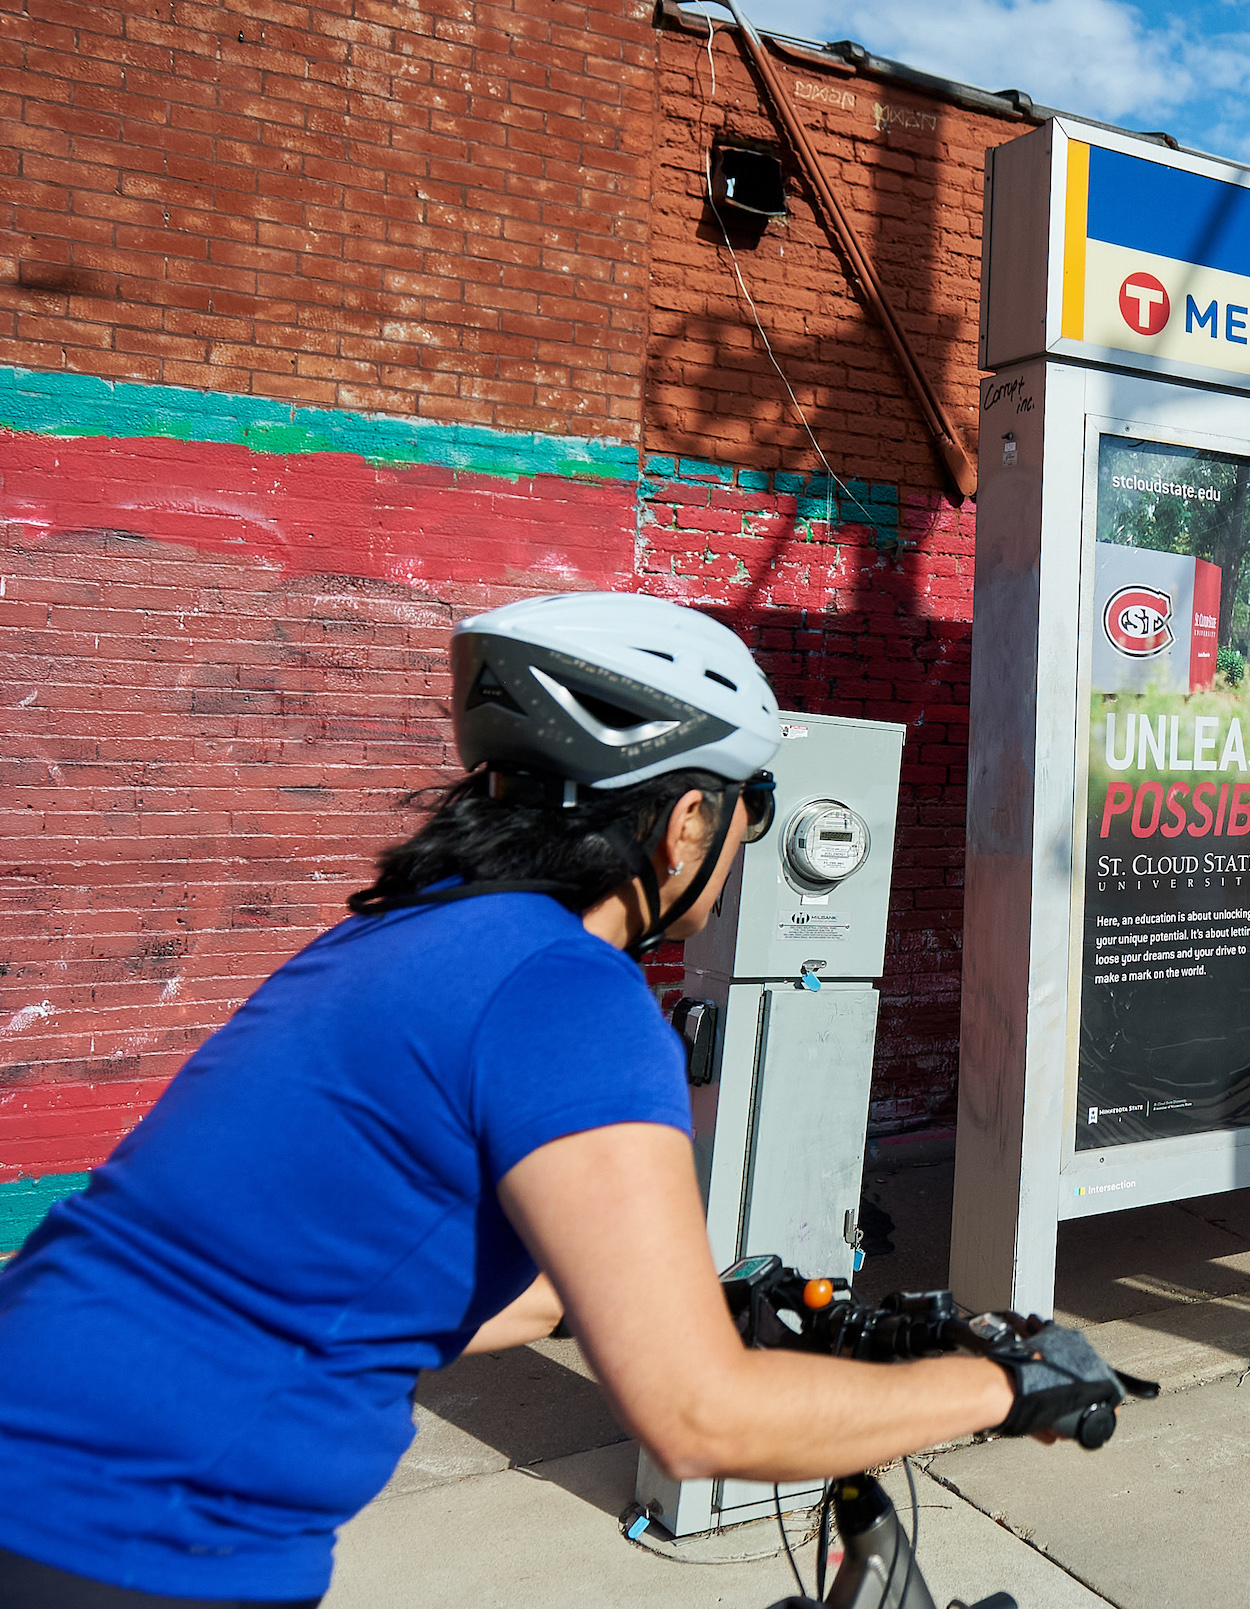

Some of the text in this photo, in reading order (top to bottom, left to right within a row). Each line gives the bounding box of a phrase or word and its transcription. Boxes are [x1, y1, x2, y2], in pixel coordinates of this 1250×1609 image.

[1112, 473, 1221, 502] stcloudstate.edu
[1097, 855, 1126, 876] ST.
[1132, 854, 1198, 876] CLOUD
[1096, 915, 1120, 928] Here,
[1122, 917, 1133, 926] an
[1135, 912, 1176, 925] education
[1178, 911, 1185, 923] is
[1187, 910, 1211, 922] about
[1096, 937, 1117, 949] your
[1118, 934, 1148, 947] unique
[1150, 930, 1188, 945] potential.
[1190, 929, 1203, 940] It's
[1205, 927, 1229, 939] about
[1095, 945, 1246, 966] loose your dreams and your drive to
[1094, 964, 1206, 985] make a mark on the world.
[1088, 1180, 1136, 1195] Intersection
